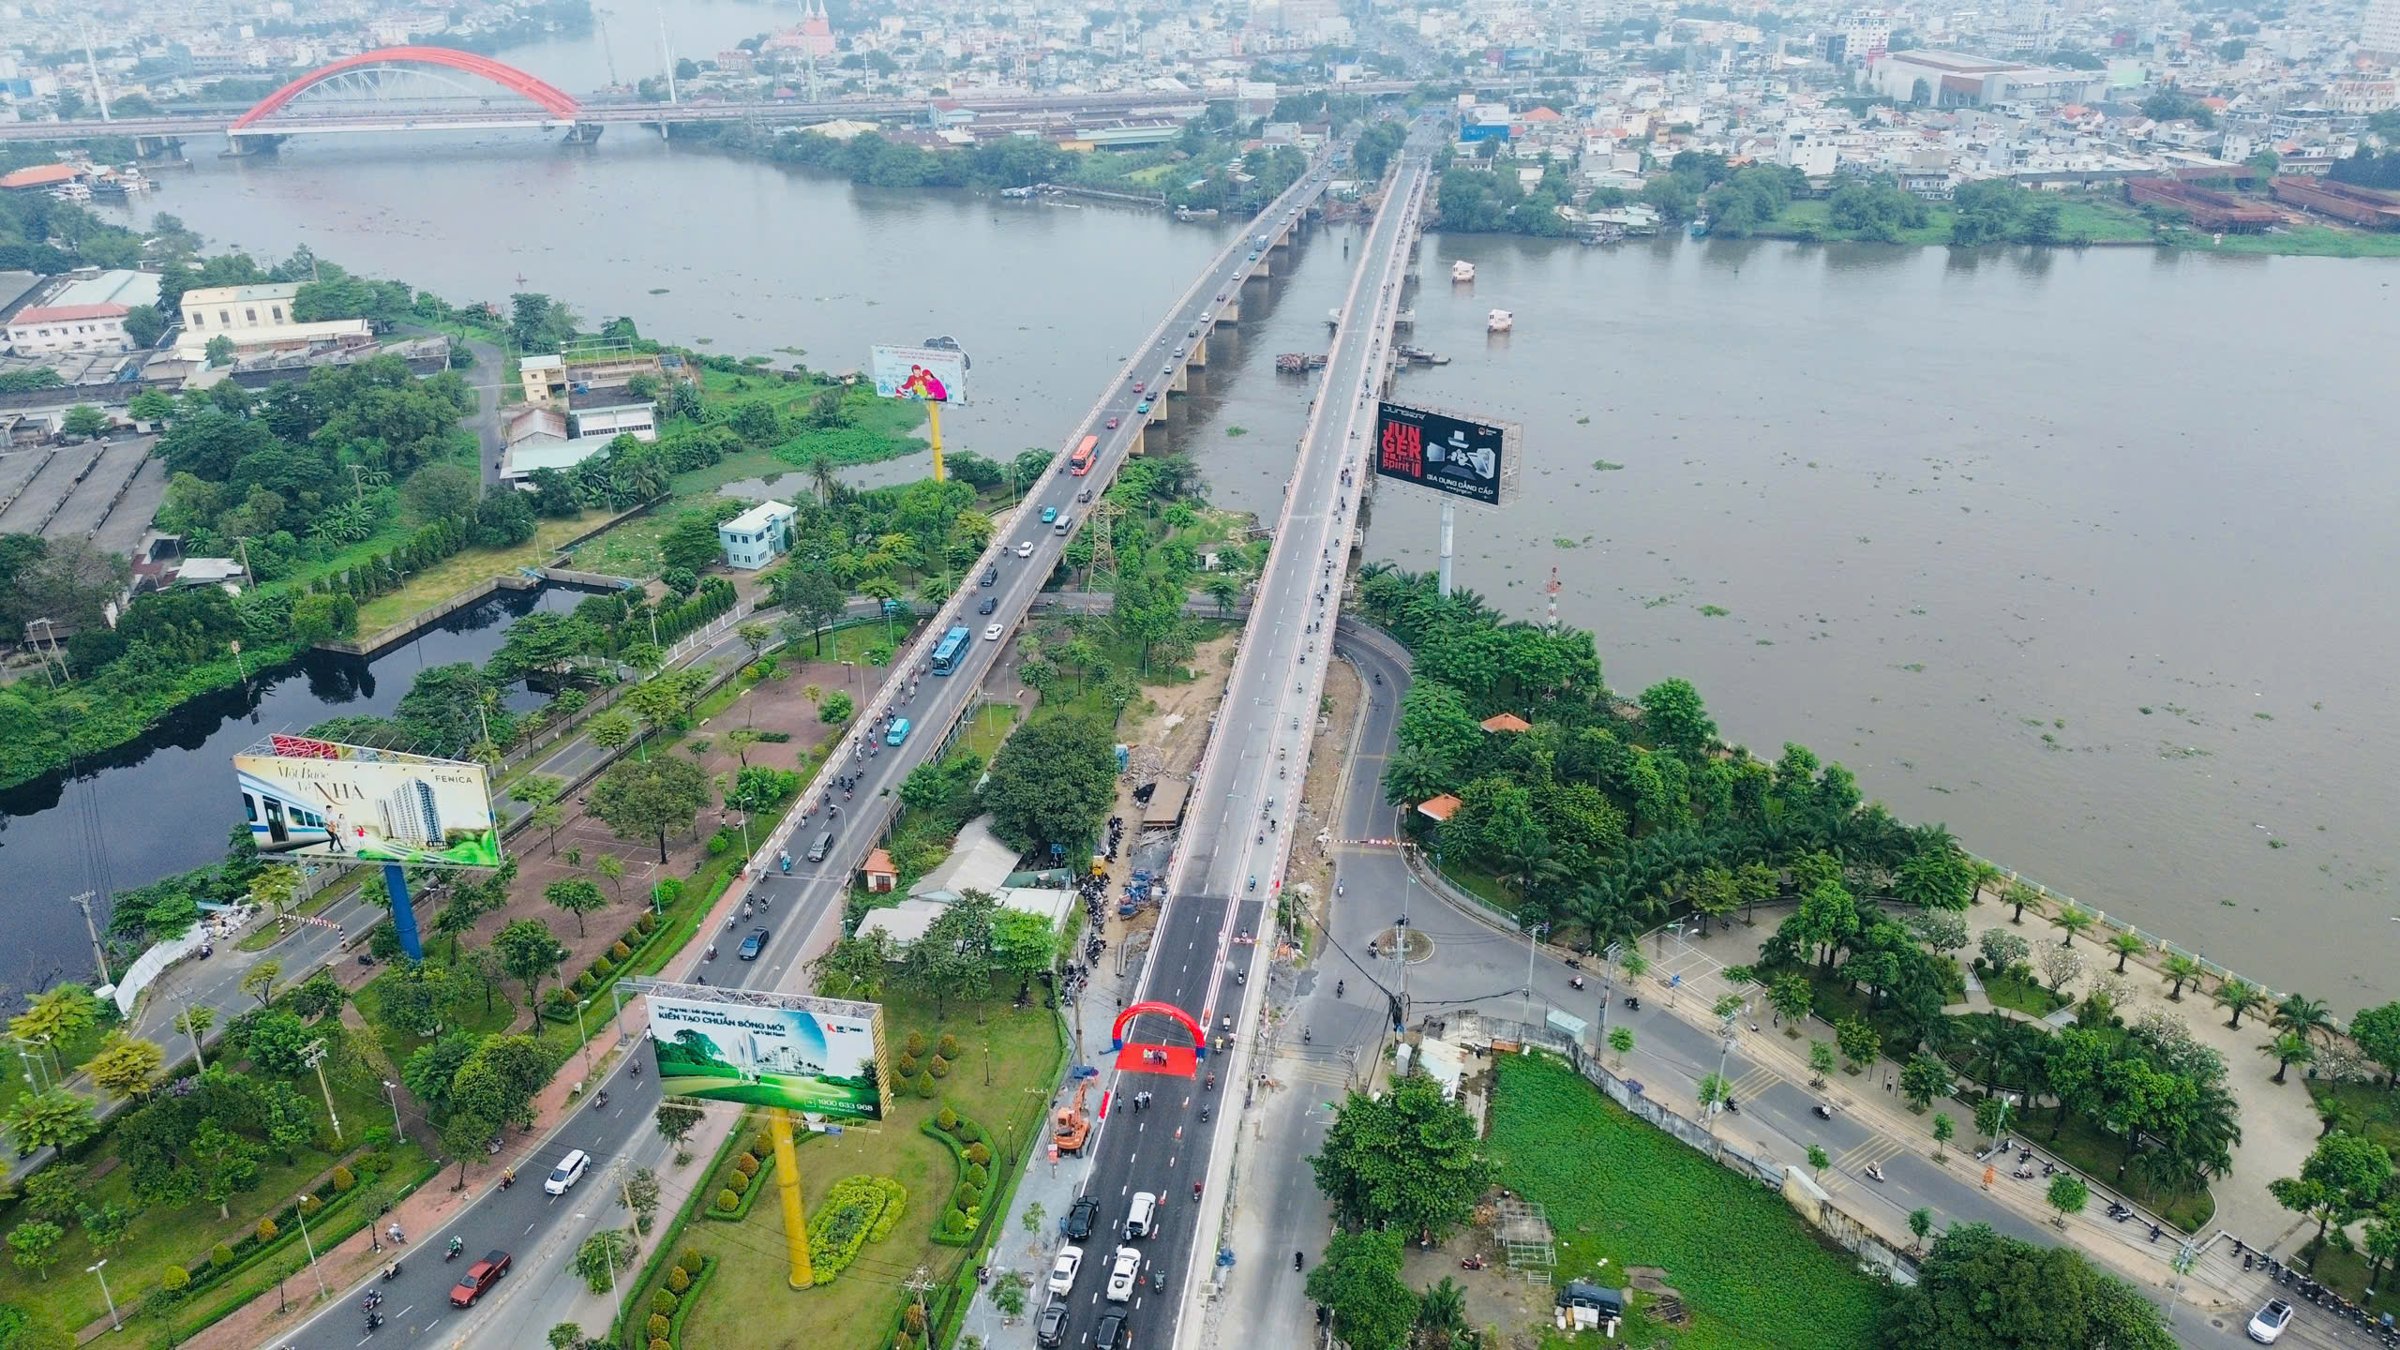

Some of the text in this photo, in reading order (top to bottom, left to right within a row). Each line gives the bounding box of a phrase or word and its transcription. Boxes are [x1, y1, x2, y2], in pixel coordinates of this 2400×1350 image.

[1382, 421, 1420, 443] JUN
[1382, 436, 1422, 460] GER
[1426, 473, 1438, 482] GIA
[435, 774, 473, 784] FENICA
[681, 1014, 701, 1023] TẠO
[702, 1015, 736, 1027] CHUẨN
[737, 1019, 765, 1030] SỐNG
[766, 1022, 786, 1032] MỚI
[818, 1098, 837, 1107] 1900
